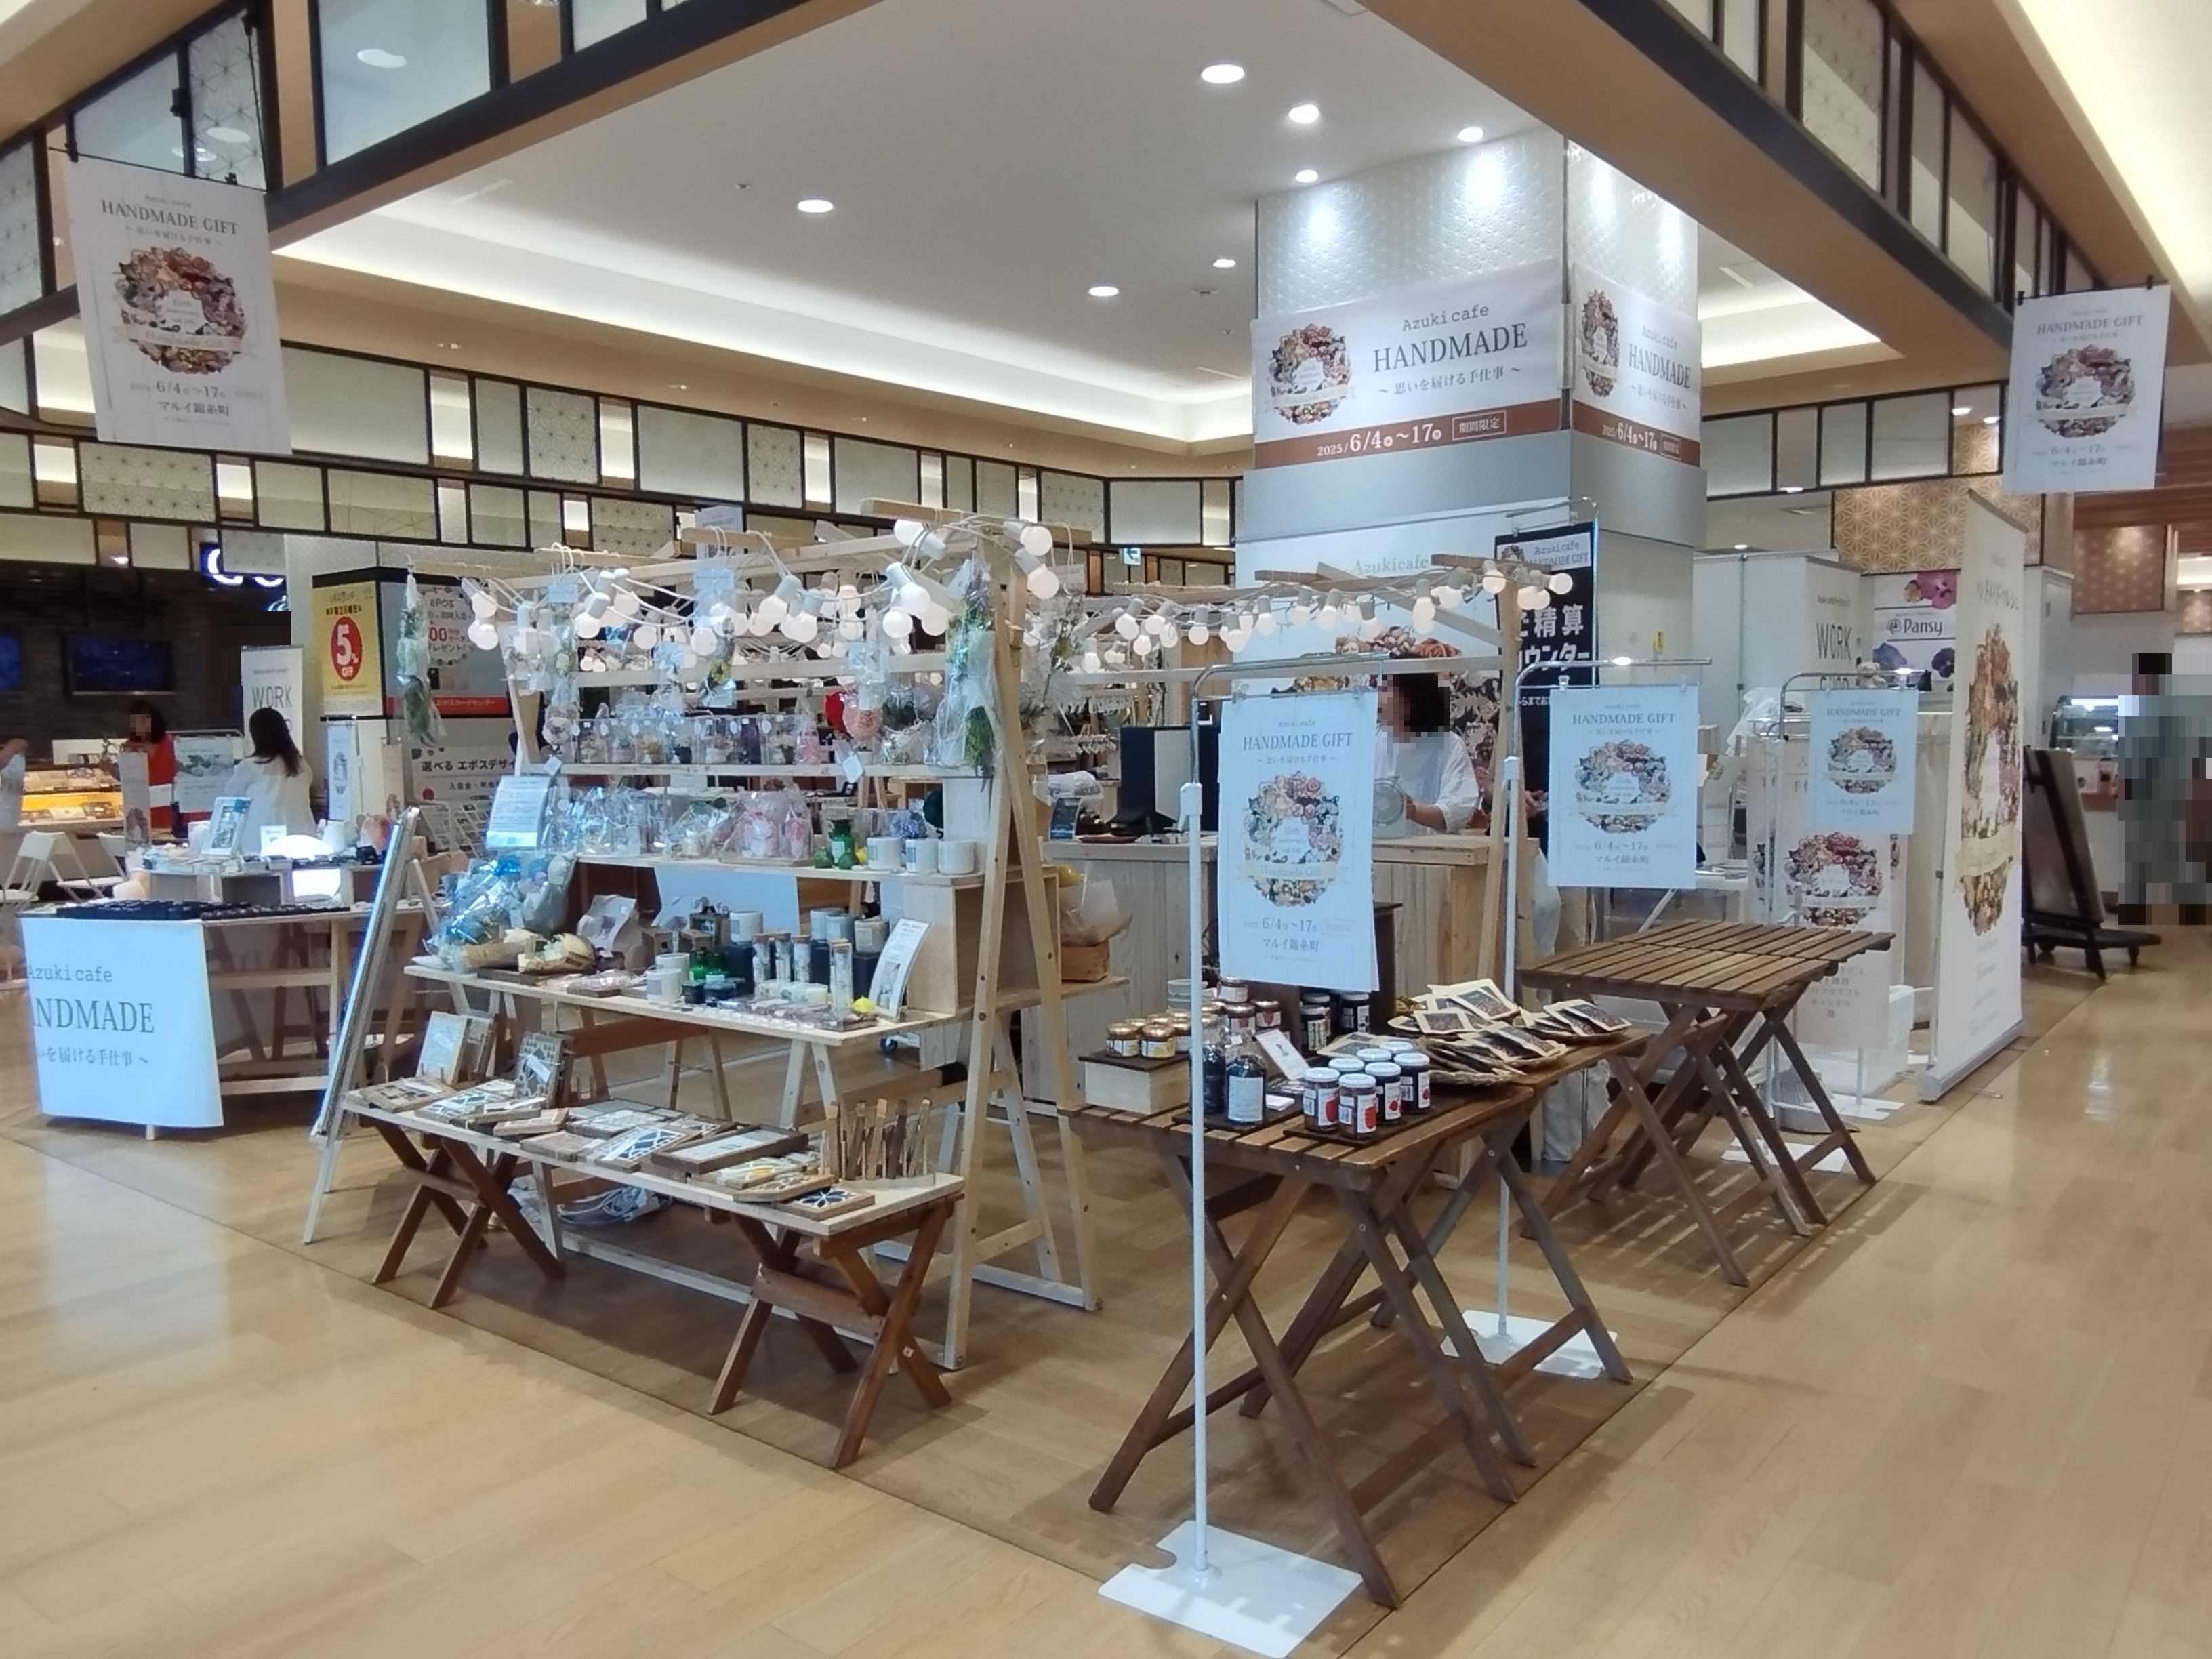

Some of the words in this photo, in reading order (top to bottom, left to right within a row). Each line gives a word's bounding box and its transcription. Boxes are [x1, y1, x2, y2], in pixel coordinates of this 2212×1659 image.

[101, 199, 198, 229] HANDMADE
[203, 218, 239, 235] GIFT
[1402, 312, 1447, 332] Azuki
[1452, 305, 1490, 323] cafe
[2036, 318, 2110, 335] HANDMADE
[2113, 314, 2143, 327] GIFT
[1373, 323, 1528, 373] HANDMADE
[1629, 344, 1692, 389] HANDMADE
[159, 401, 229, 417] マルイ錦糸町
[1458, 416, 1500, 434] 期間限定
[1904, 618, 1942, 636] Pansy
[1816, 623, 1852, 660] WORK
[251, 685, 293, 709] WORK
[1573, 714, 1643, 724] HANDMADE
[1647, 713, 1675, 724] GIFT
[1243, 733, 1318, 750] HANDMADE
[1322, 732, 1353, 747] GIFT
[422, 761, 453, 771] 選べる
[1263, 938, 1319, 953] マルイ錦糸町
[75, 966, 113, 983] cafe
[33, 998, 155, 1033] NDMADE
